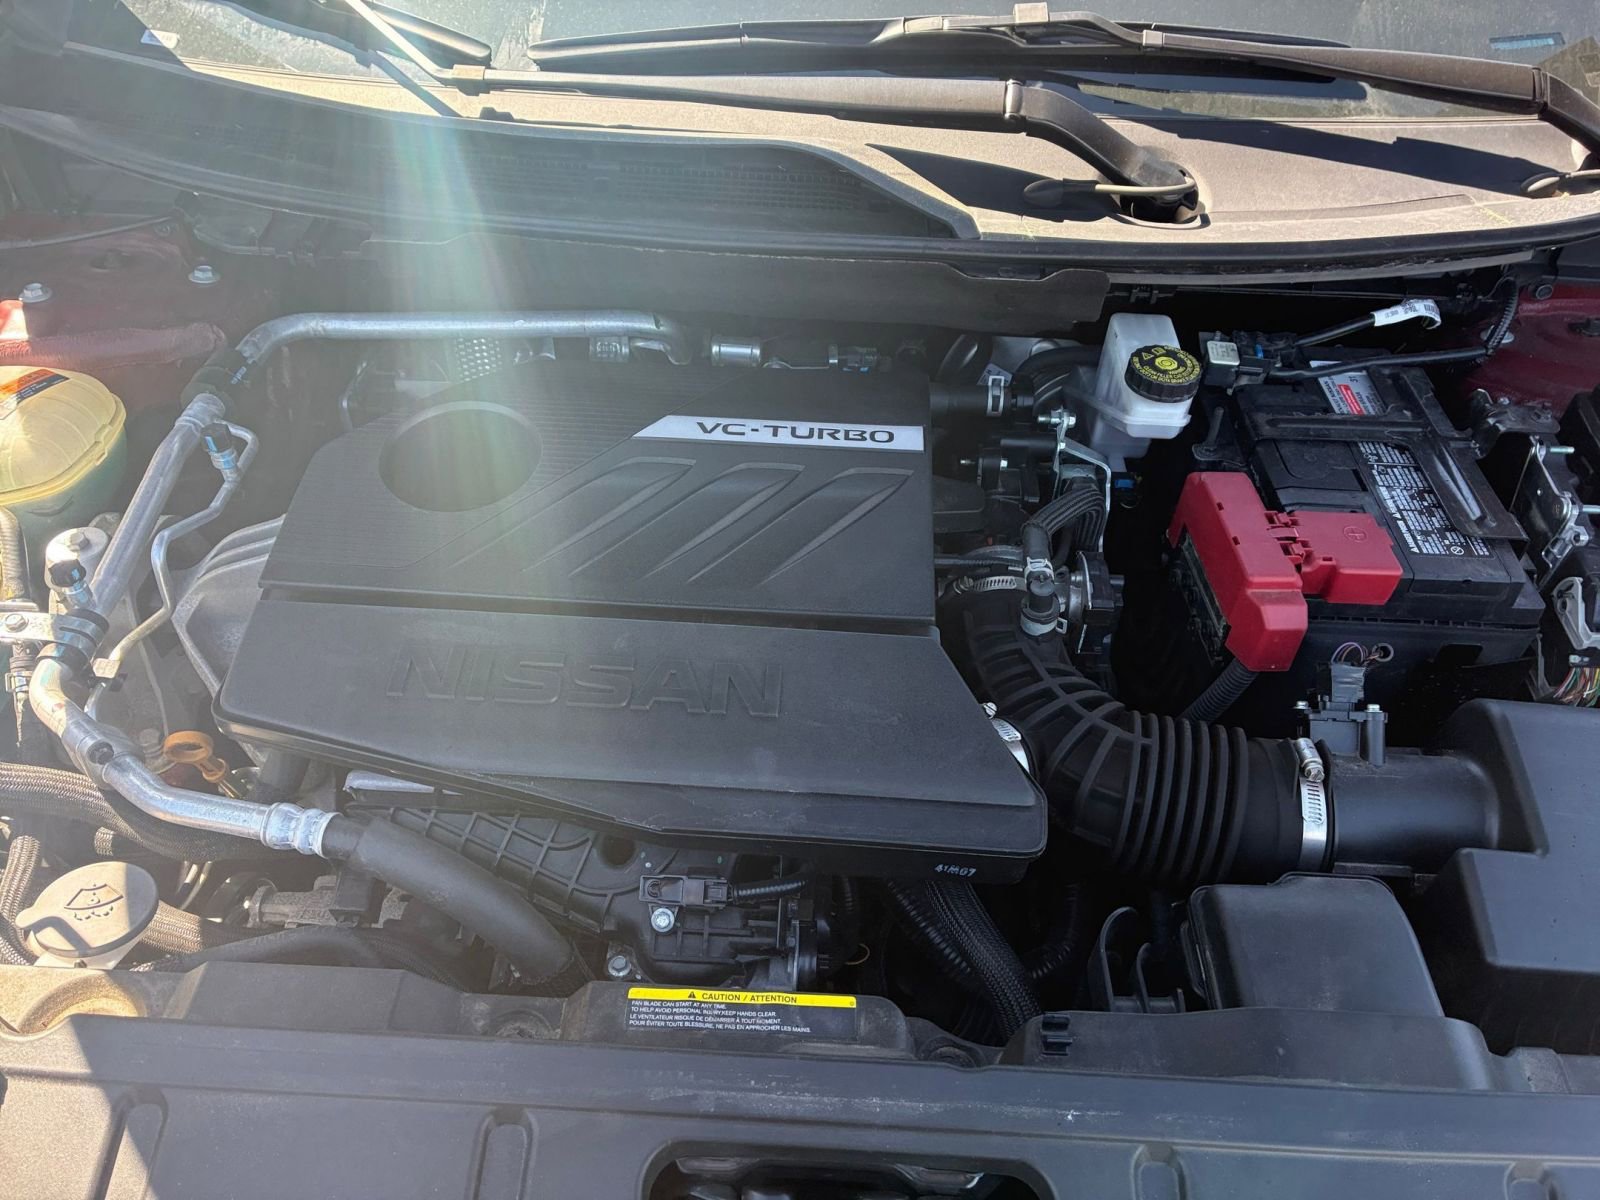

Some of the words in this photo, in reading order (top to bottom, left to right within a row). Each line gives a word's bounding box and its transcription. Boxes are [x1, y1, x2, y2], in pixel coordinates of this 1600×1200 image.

[696, 421, 895, 444] VC-TURBO
[386, 645, 783, 719] NISSAN
[702, 993, 740, 1001] CAUTION
[750, 994, 797, 1003] ATTENTION
